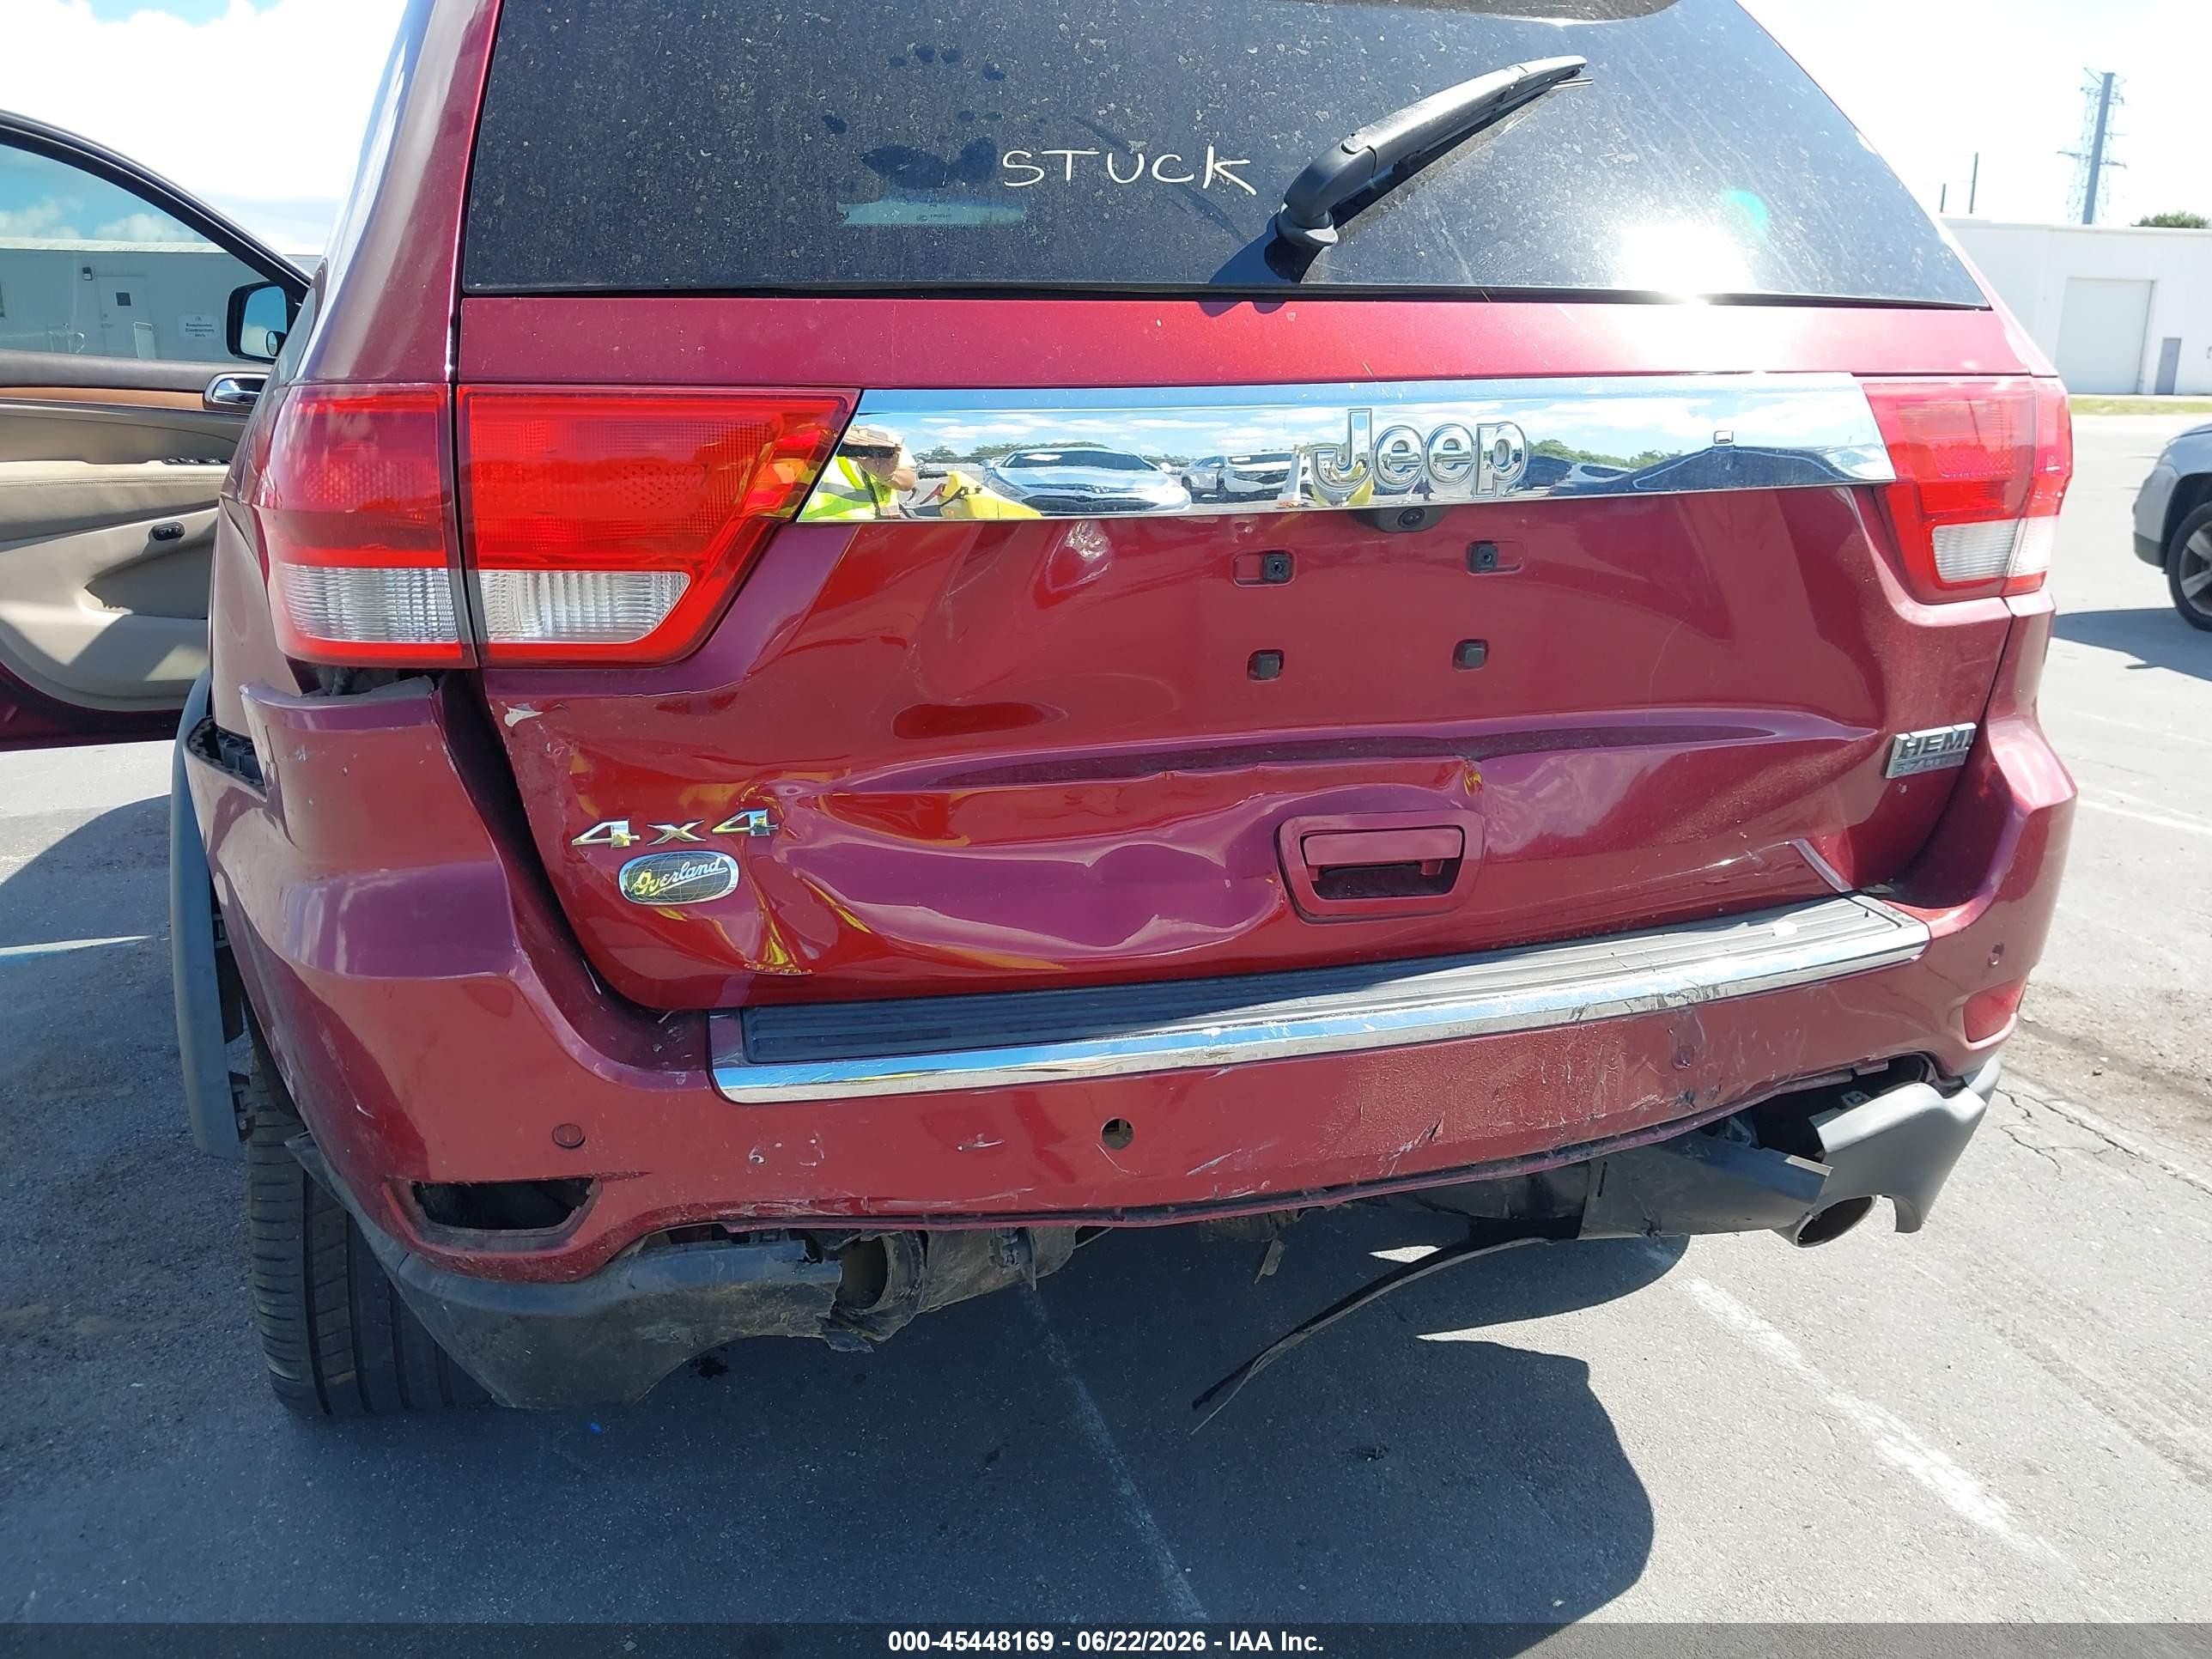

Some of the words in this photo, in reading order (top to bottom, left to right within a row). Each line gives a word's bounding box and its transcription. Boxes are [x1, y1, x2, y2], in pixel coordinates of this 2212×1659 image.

[1002, 143, 1258, 196] STUCK
[1311, 408, 1528, 498] Jeep
[629, 857, 729, 896] Overland
